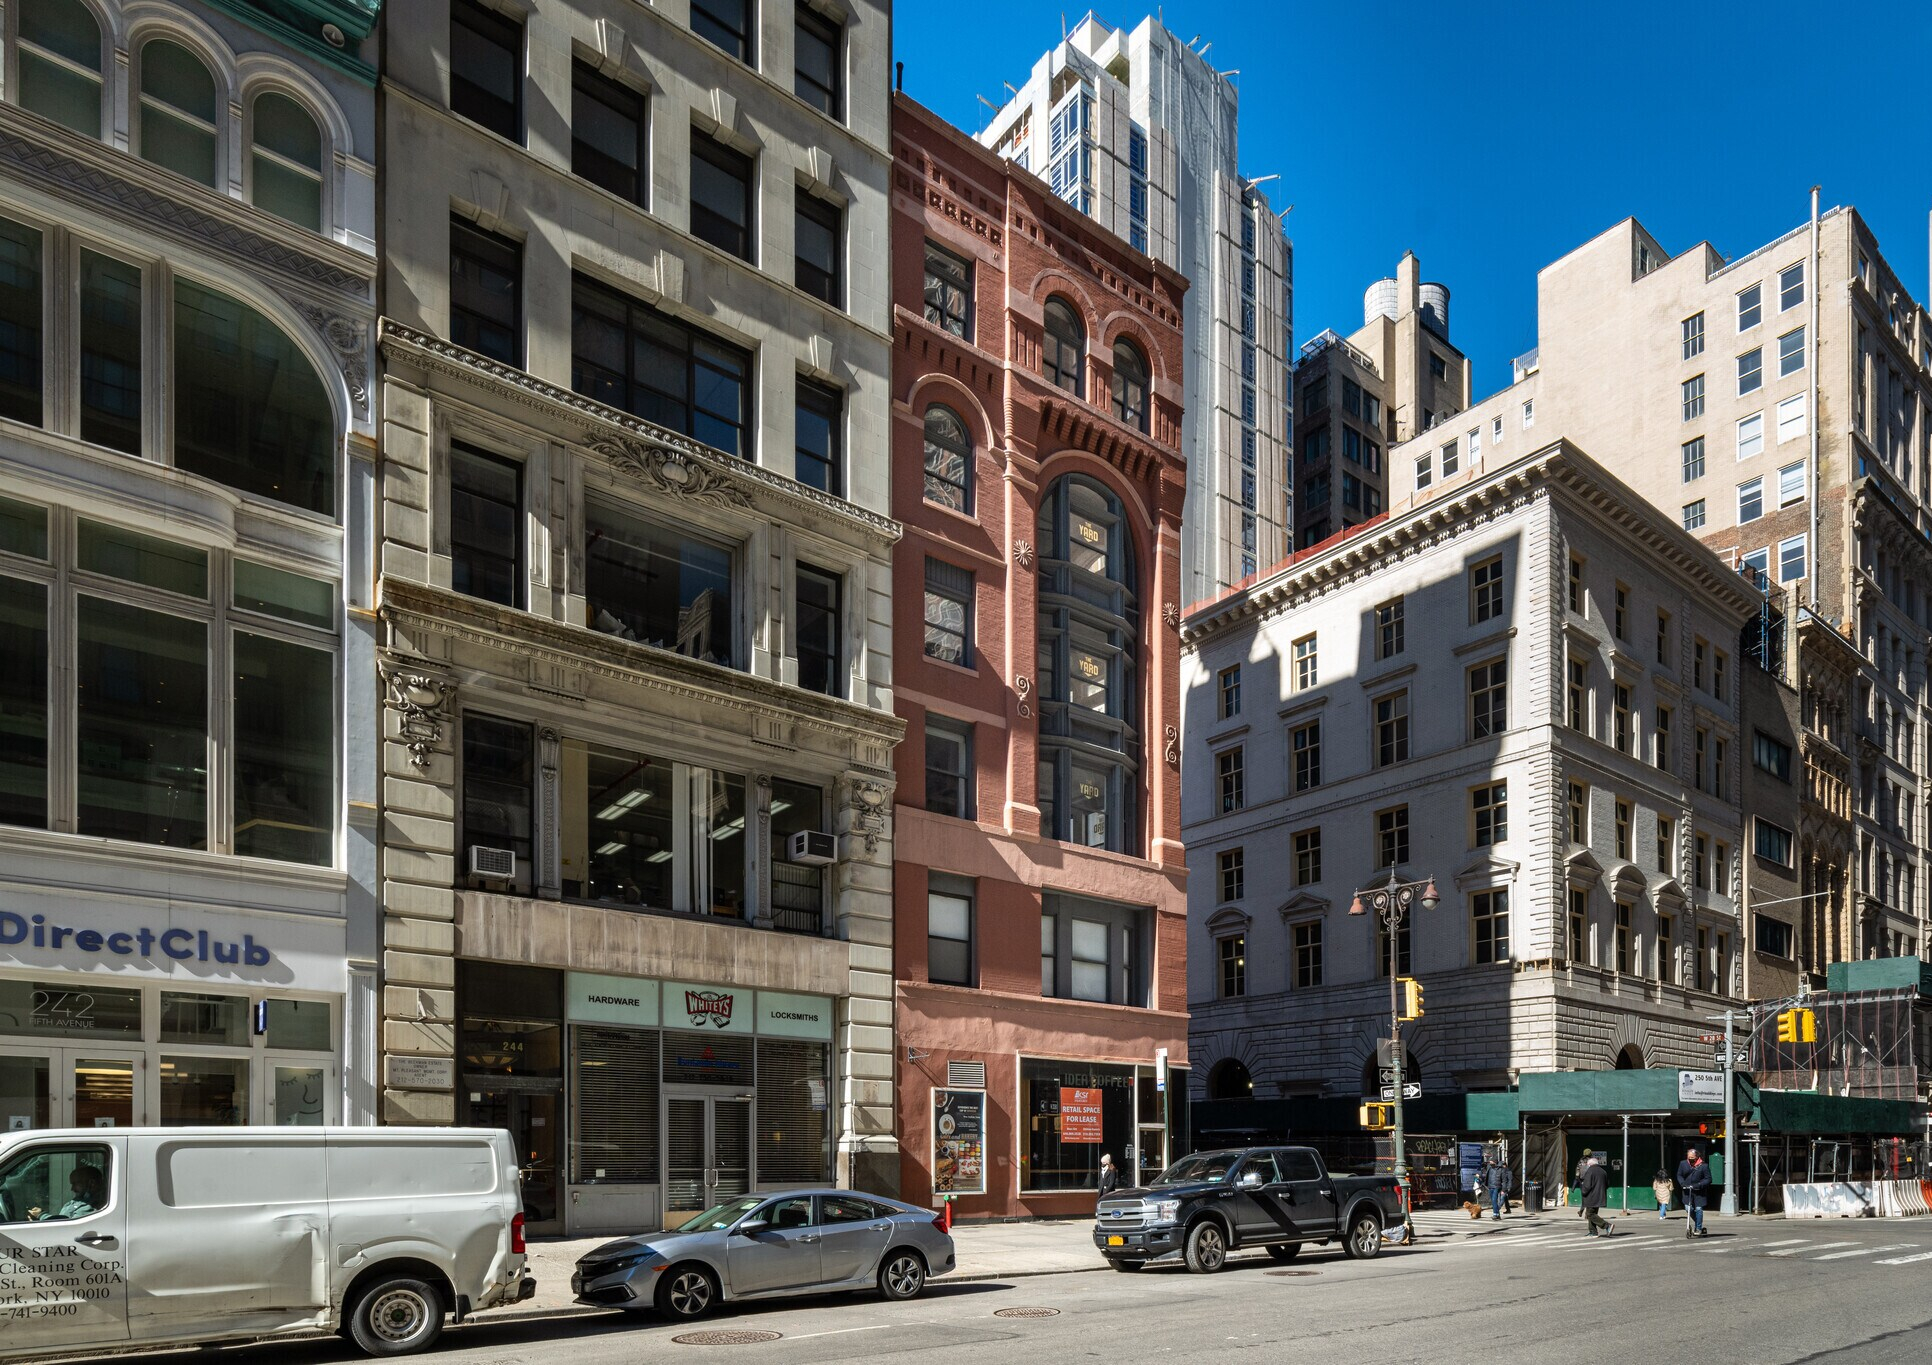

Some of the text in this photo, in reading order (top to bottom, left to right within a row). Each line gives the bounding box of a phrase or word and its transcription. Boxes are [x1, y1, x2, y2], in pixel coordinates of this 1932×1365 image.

[1079, 524, 1099, 542] YARD
[1079, 659, 1099, 676] YARD
[1080, 783, 1099, 798] YARD
[0, 911, 271, 966] DirectClub
[29, 990, 95, 1019] 242
[588, 995, 640, 1007] HARDWARE
[688, 997, 730, 1016] WHITEYS
[56, 1019, 95, 1028] AVENUE
[771, 1011, 819, 1022] LOCKSMITHS
[503, 1041, 523, 1051] 244
[1064, 1073, 1088, 1086] IDEA
[1083, 1106, 1100, 1114] SPACE
[32, 1246, 79, 1258] STAR
[0, 1259, 124, 1274] Cleaning Corp.
[1, 1273, 122, 1290] St., Room 601A
[36, 1290, 63, 1302] NY
[72, 1288, 110, 1300] 10010
